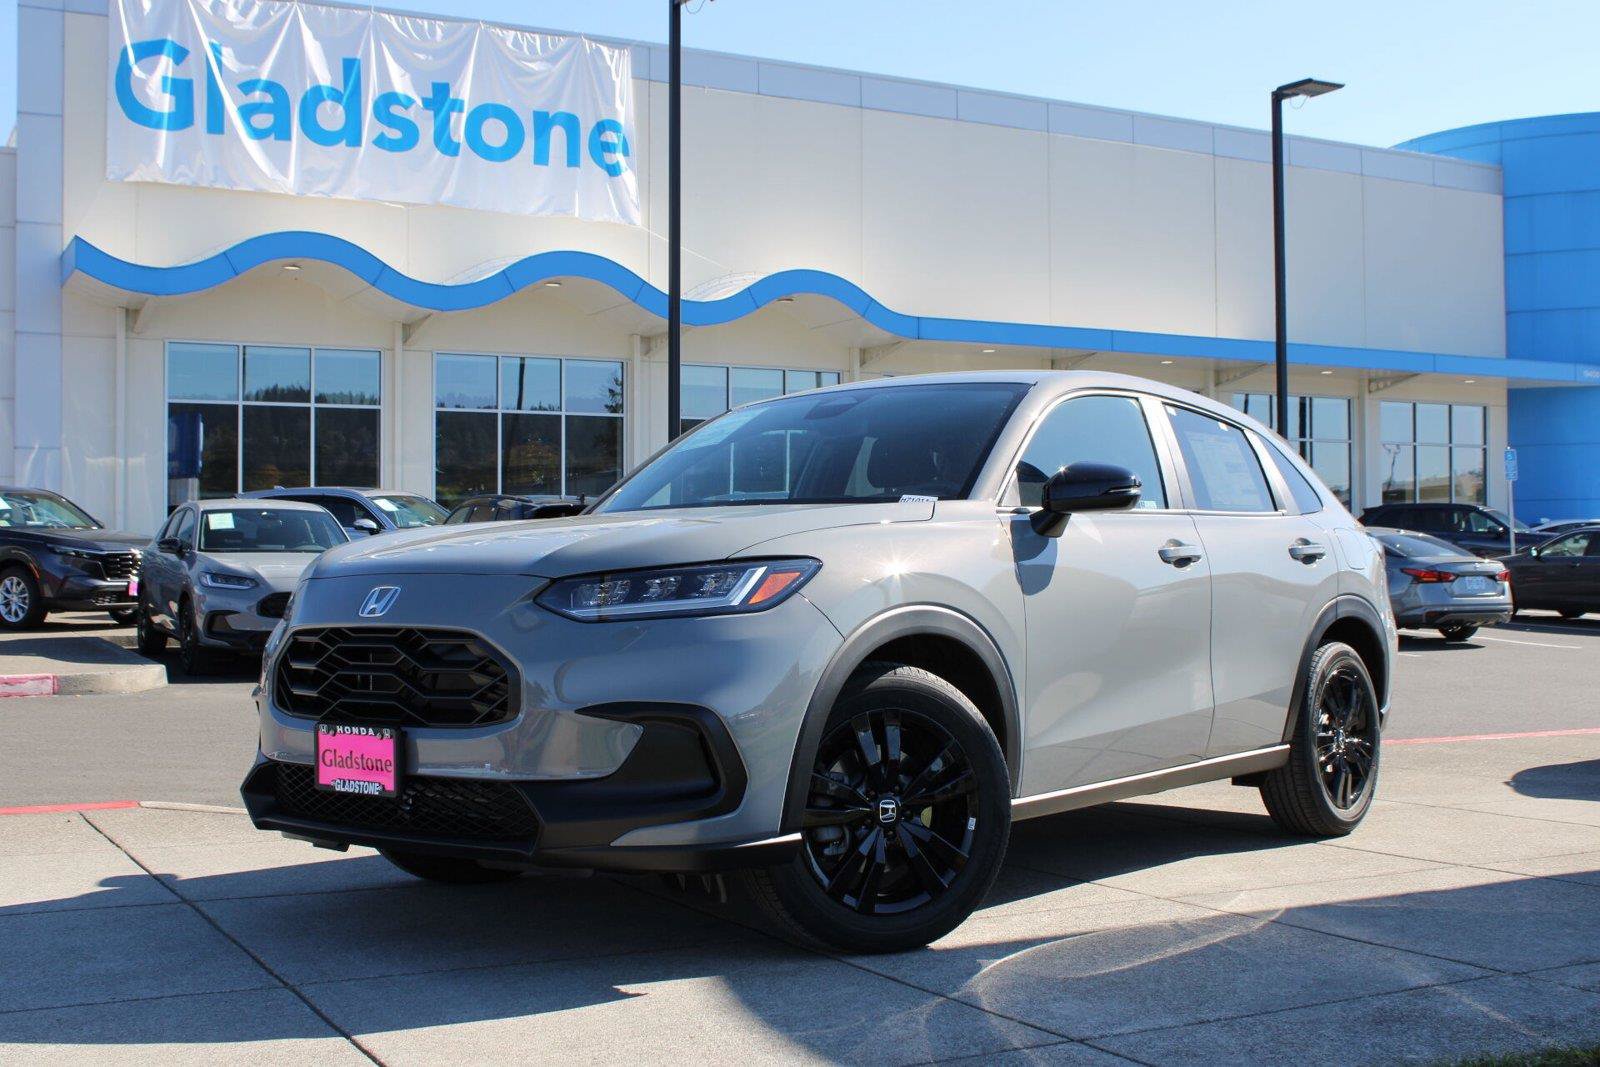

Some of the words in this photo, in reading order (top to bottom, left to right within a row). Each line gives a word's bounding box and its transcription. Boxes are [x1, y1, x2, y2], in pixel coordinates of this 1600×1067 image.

[115, 38, 631, 177] Gladstone
[336, 725, 375, 736] HONDA
[321, 749, 393, 773] Gladstone
[335, 779, 379, 795] GLADSTONE
